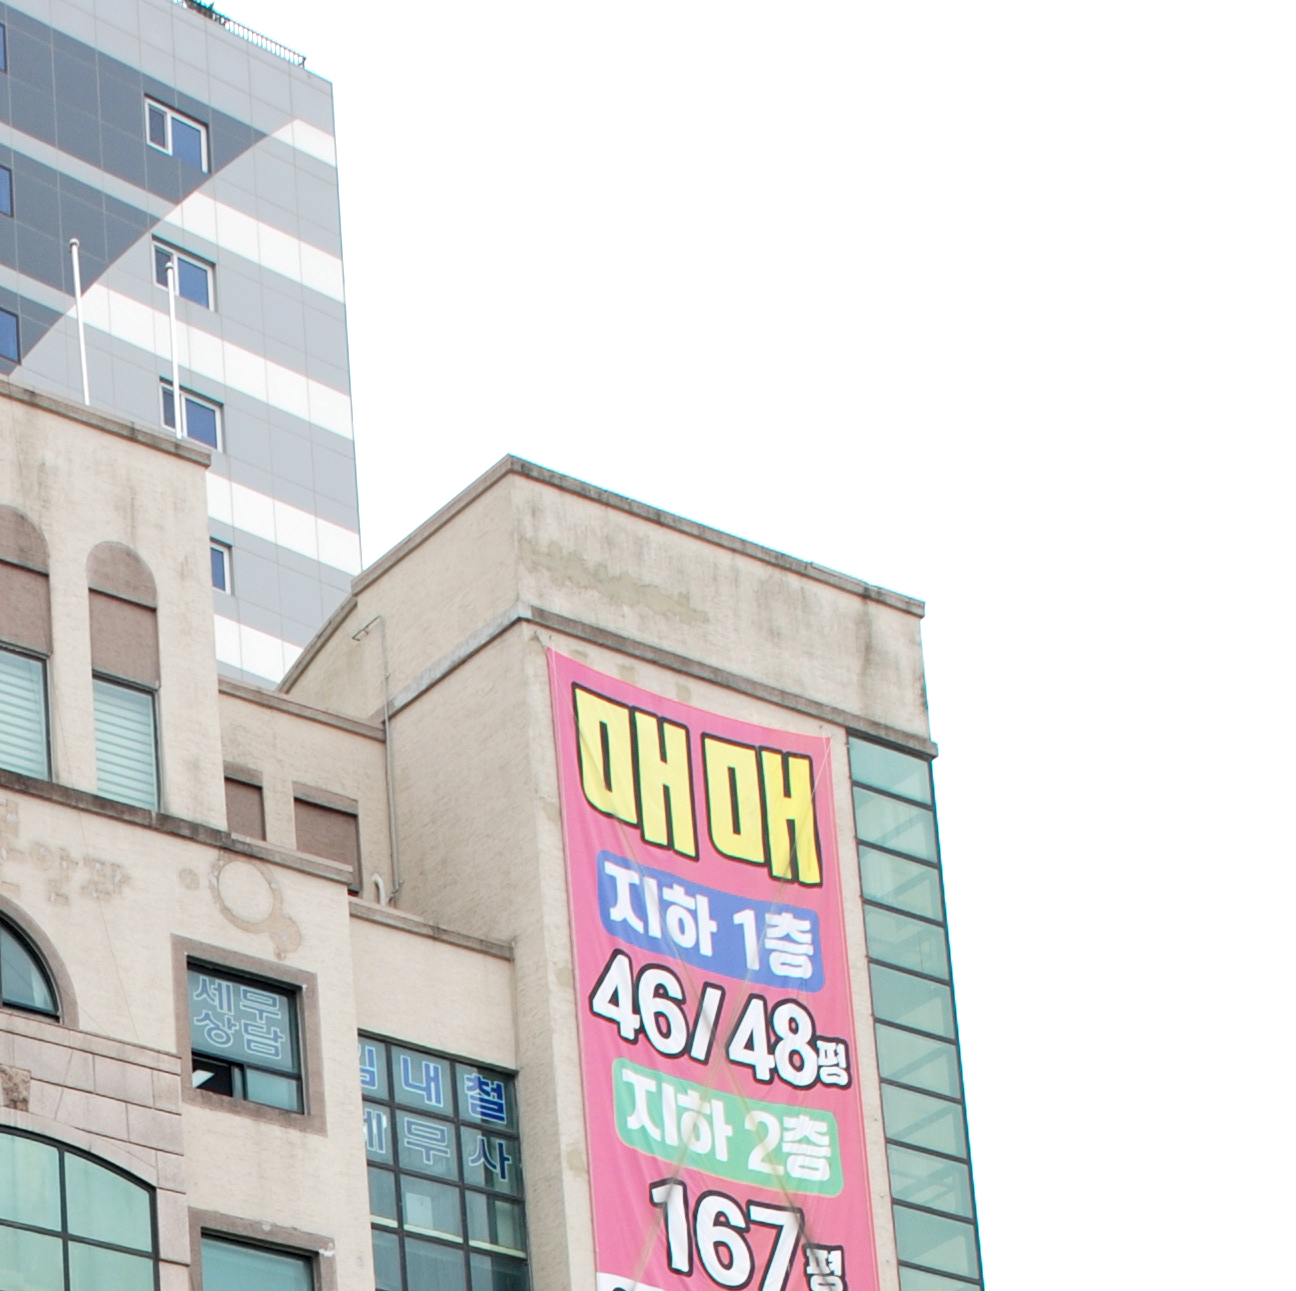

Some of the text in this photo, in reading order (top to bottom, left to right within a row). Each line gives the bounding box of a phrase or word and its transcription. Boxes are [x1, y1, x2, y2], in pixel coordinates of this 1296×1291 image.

[572, 682, 823, 887] 매매
[603, 860, 815, 980] 지하 1층
[193, 975, 281, 1023] 세무
[194, 1011, 286, 1059] 상담
[590, 948, 851, 1090] 46/48평
[622, 1069, 833, 1180] 지하 2층
